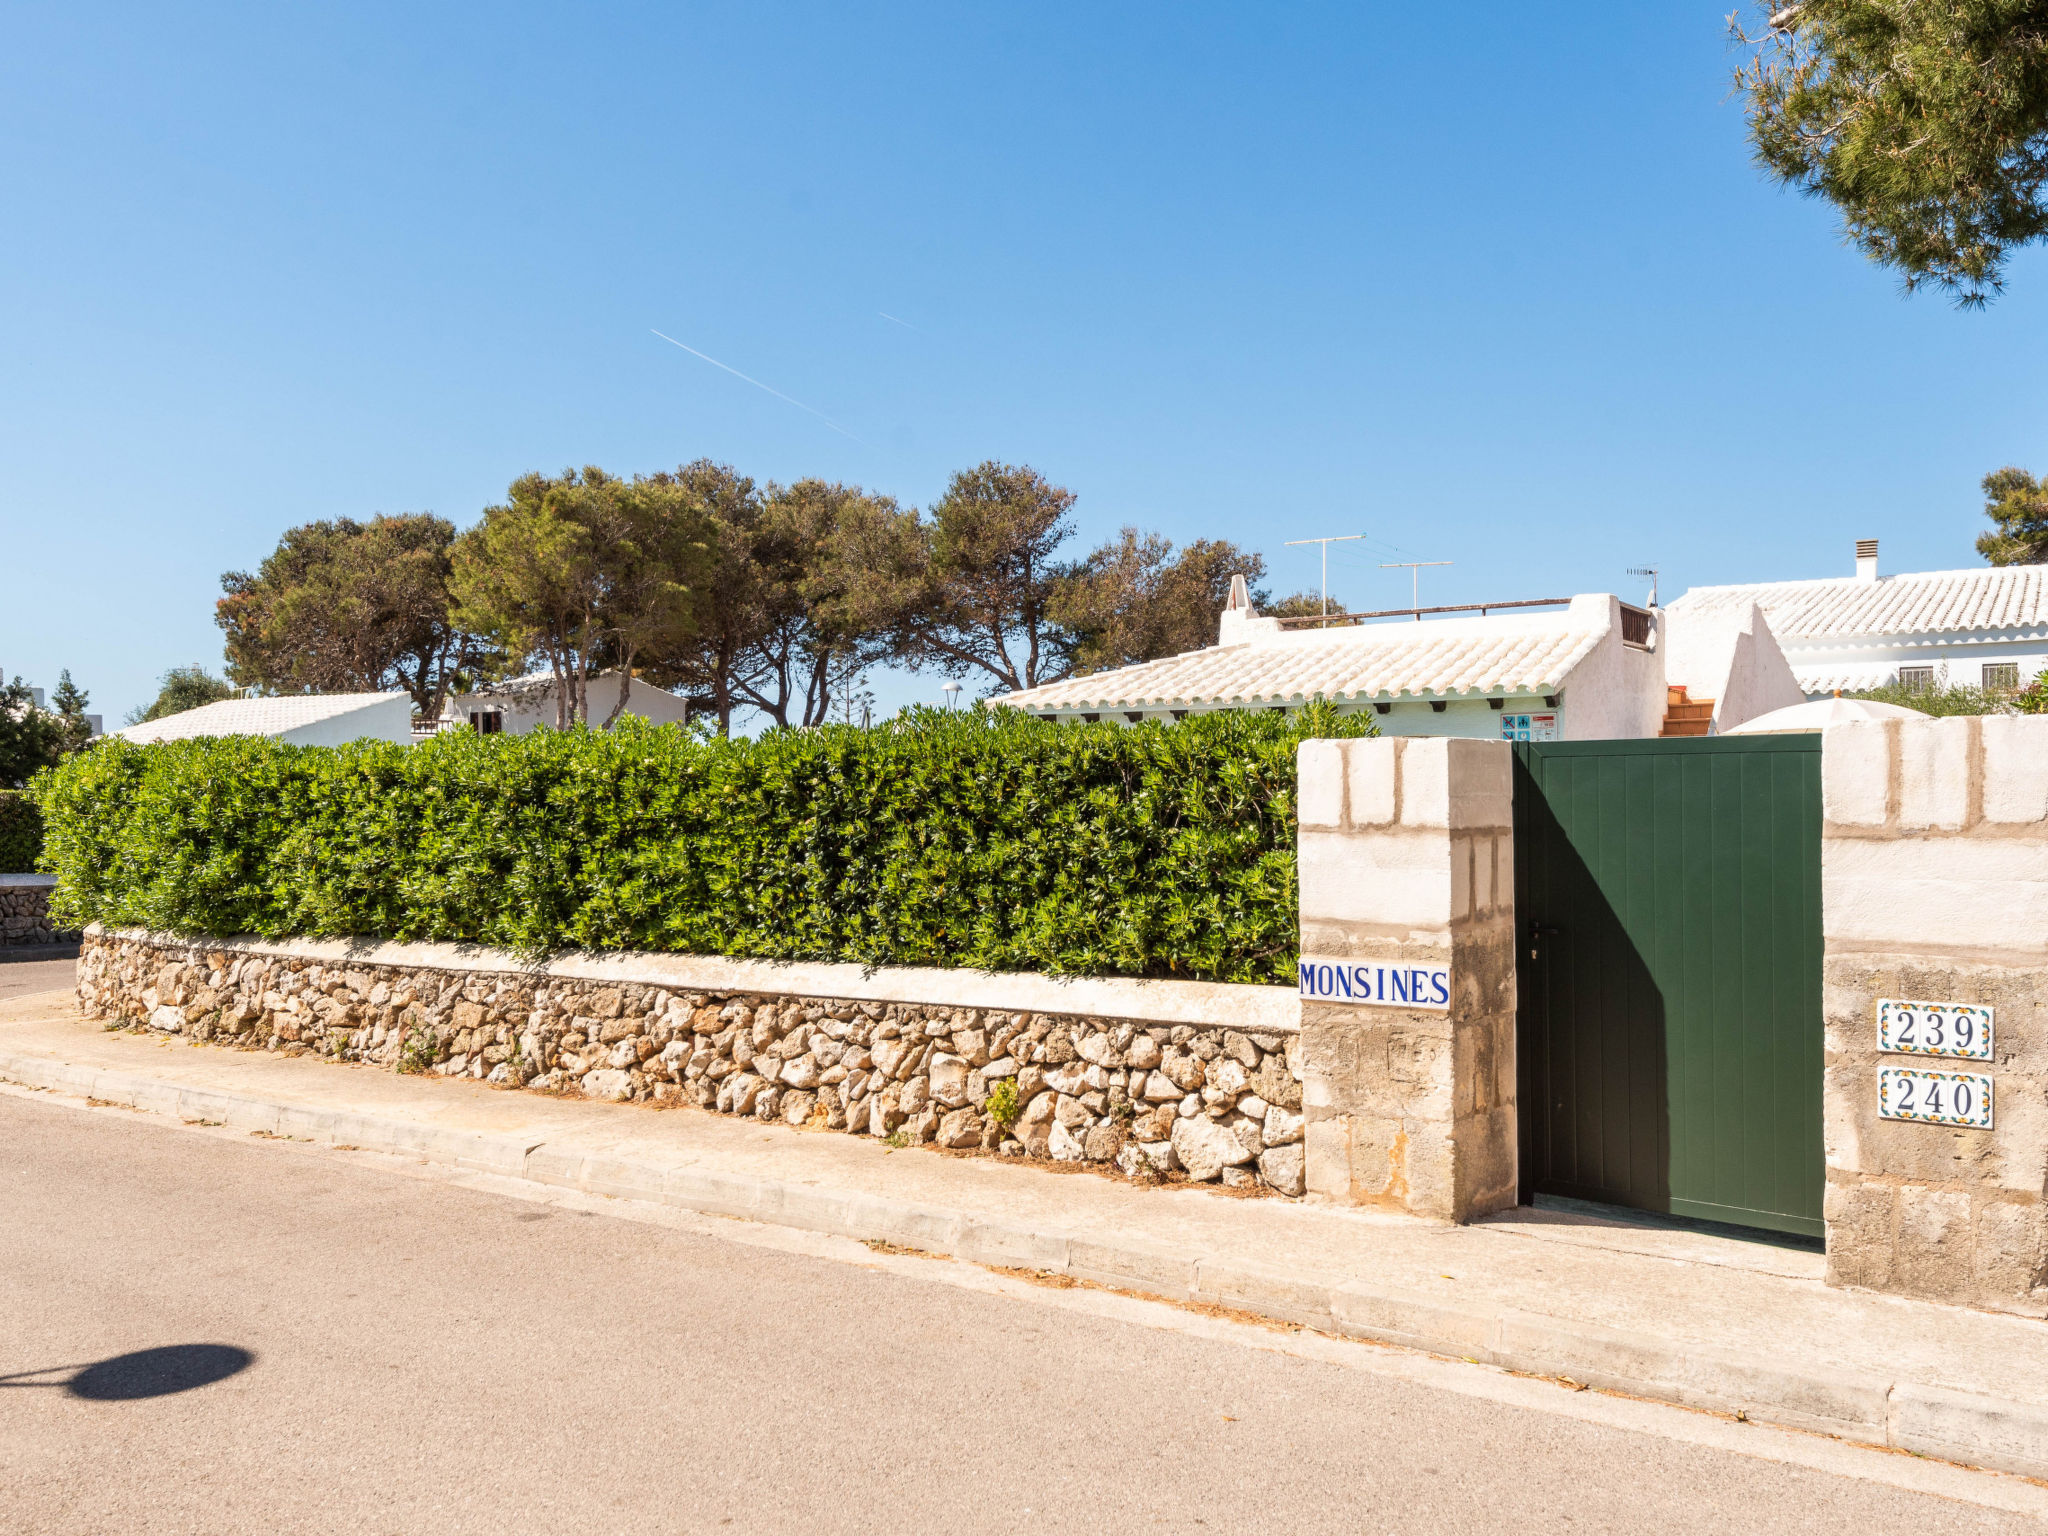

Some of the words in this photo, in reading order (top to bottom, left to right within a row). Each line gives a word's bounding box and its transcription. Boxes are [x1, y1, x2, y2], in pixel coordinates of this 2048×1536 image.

[1300, 963, 1449, 1004] MONSINES
[1897, 1011, 1974, 1048] 239
[1897, 1078, 1972, 1116] 240
